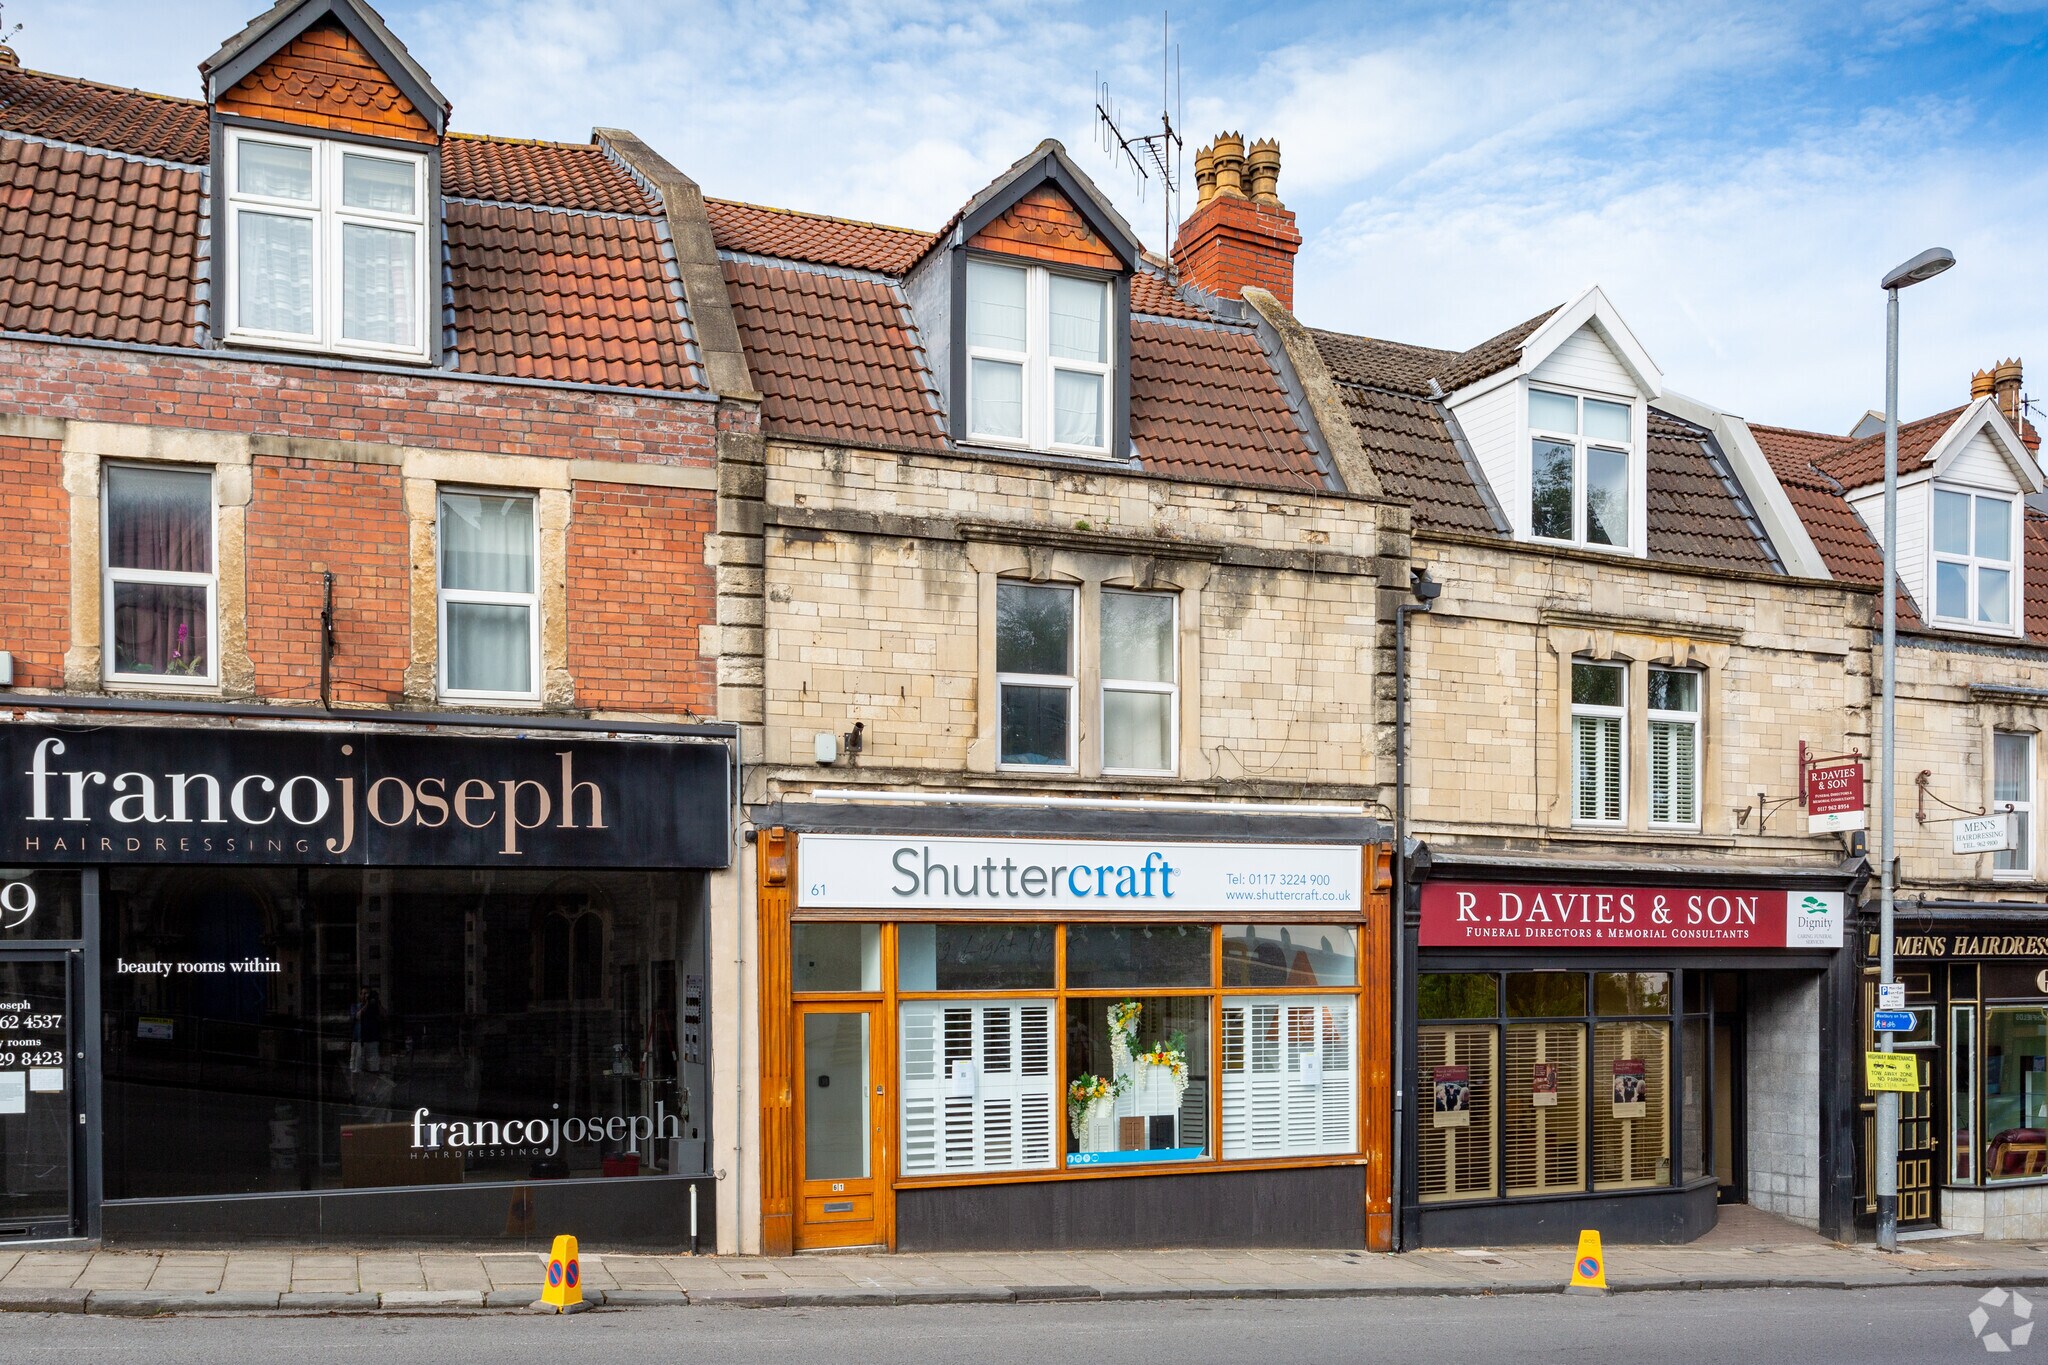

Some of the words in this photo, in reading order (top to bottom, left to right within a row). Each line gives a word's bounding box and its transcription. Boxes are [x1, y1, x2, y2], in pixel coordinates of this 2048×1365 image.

[1818, 782, 1825, 790] &
[1827, 779, 1848, 789] SON
[1964, 820, 1996, 832] MEN'S
[1956, 831, 2004, 842] HAIRDRESSING
[25, 836, 310, 852] HAIRDRESSING
[1226, 873, 1245, 885] Tel:
[1248, 873, 1276, 885] 0117
[1279, 874, 1306, 886] 3224
[1310, 874, 1330, 886] 900
[811, 884, 826, 896] 61
[1226, 888, 1351, 901] www.shuttercraft.co.uk
[0, 882, 37, 929] 9
[1651, 894, 1673, 925] &
[1687, 895, 1758, 925] SON
[1798, 916, 1833, 931] Dignity
[1466, 926, 1521, 937] FUNERAL
[1525, 926, 1592, 938] DIRECTORS
[1596, 928, 1602, 938] &
[1608, 928, 1667, 938] MEMORIAL
[1671, 928, 1749, 939] CONSULTANTS
[1893, 936, 1946, 956] MENS
[117, 957, 173, 978] beauty
[176, 961, 226, 973] rooms
[229, 957, 282, 973] within
[23, 1015, 62, 1029] 4537
[7, 1038, 42, 1047] rooms
[21, 1051, 63, 1066] 8423
[410, 1147, 539, 1160] HAIRDRESSING
